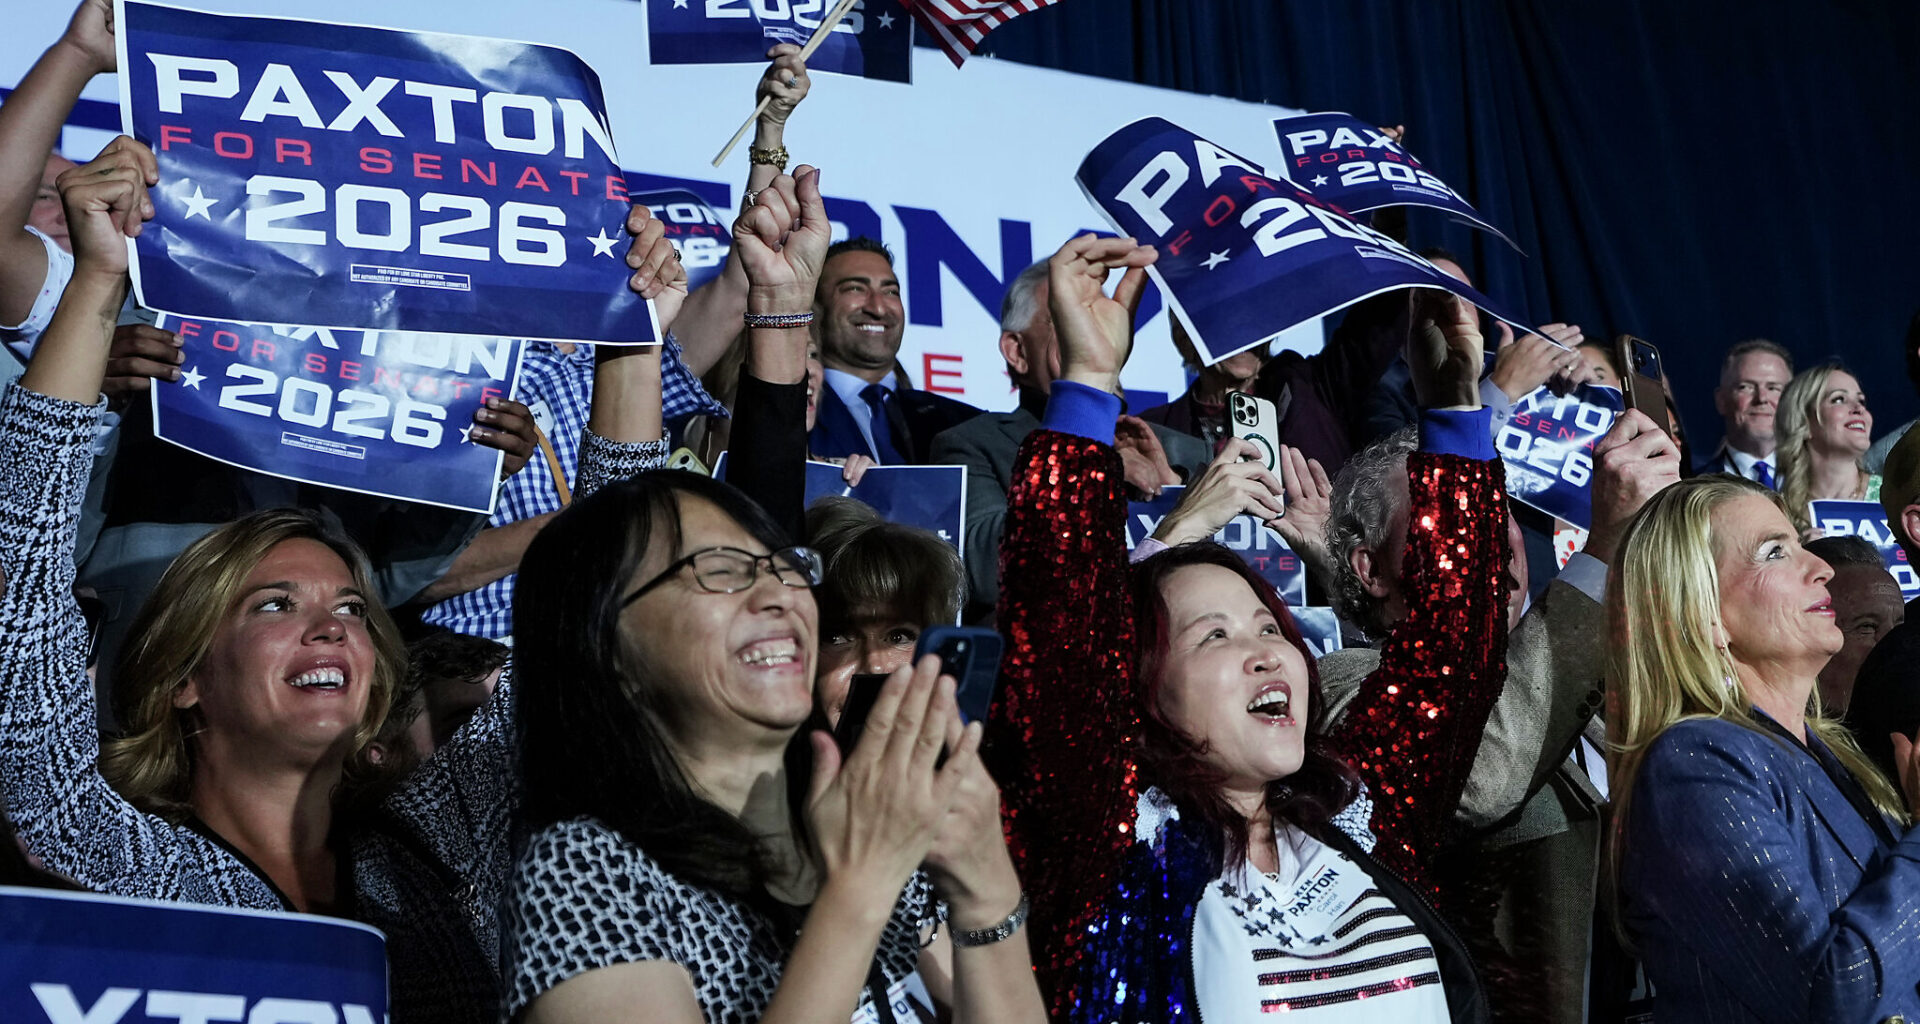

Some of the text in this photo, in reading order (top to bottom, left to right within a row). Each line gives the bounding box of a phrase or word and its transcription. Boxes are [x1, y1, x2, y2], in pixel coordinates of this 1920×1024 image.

[145, 52, 620, 168] PAXTON
[1286, 127, 1402, 155] PAX
[1296, 149, 1366, 168] FOR
[160, 125, 312, 166] FOR
[359, 147, 630, 203] SENATE
[1337, 161, 1452, 197] 202
[245, 174, 566, 267] 2026
[178, 321, 275, 361] FOR
[218, 363, 448, 449] 2026
[1496, 425, 1593, 487] 026
[1821, 518, 1896, 547] PAX
[1288, 868, 1340, 917] PAXTON
[1294, 879, 1313, 898] KEN
